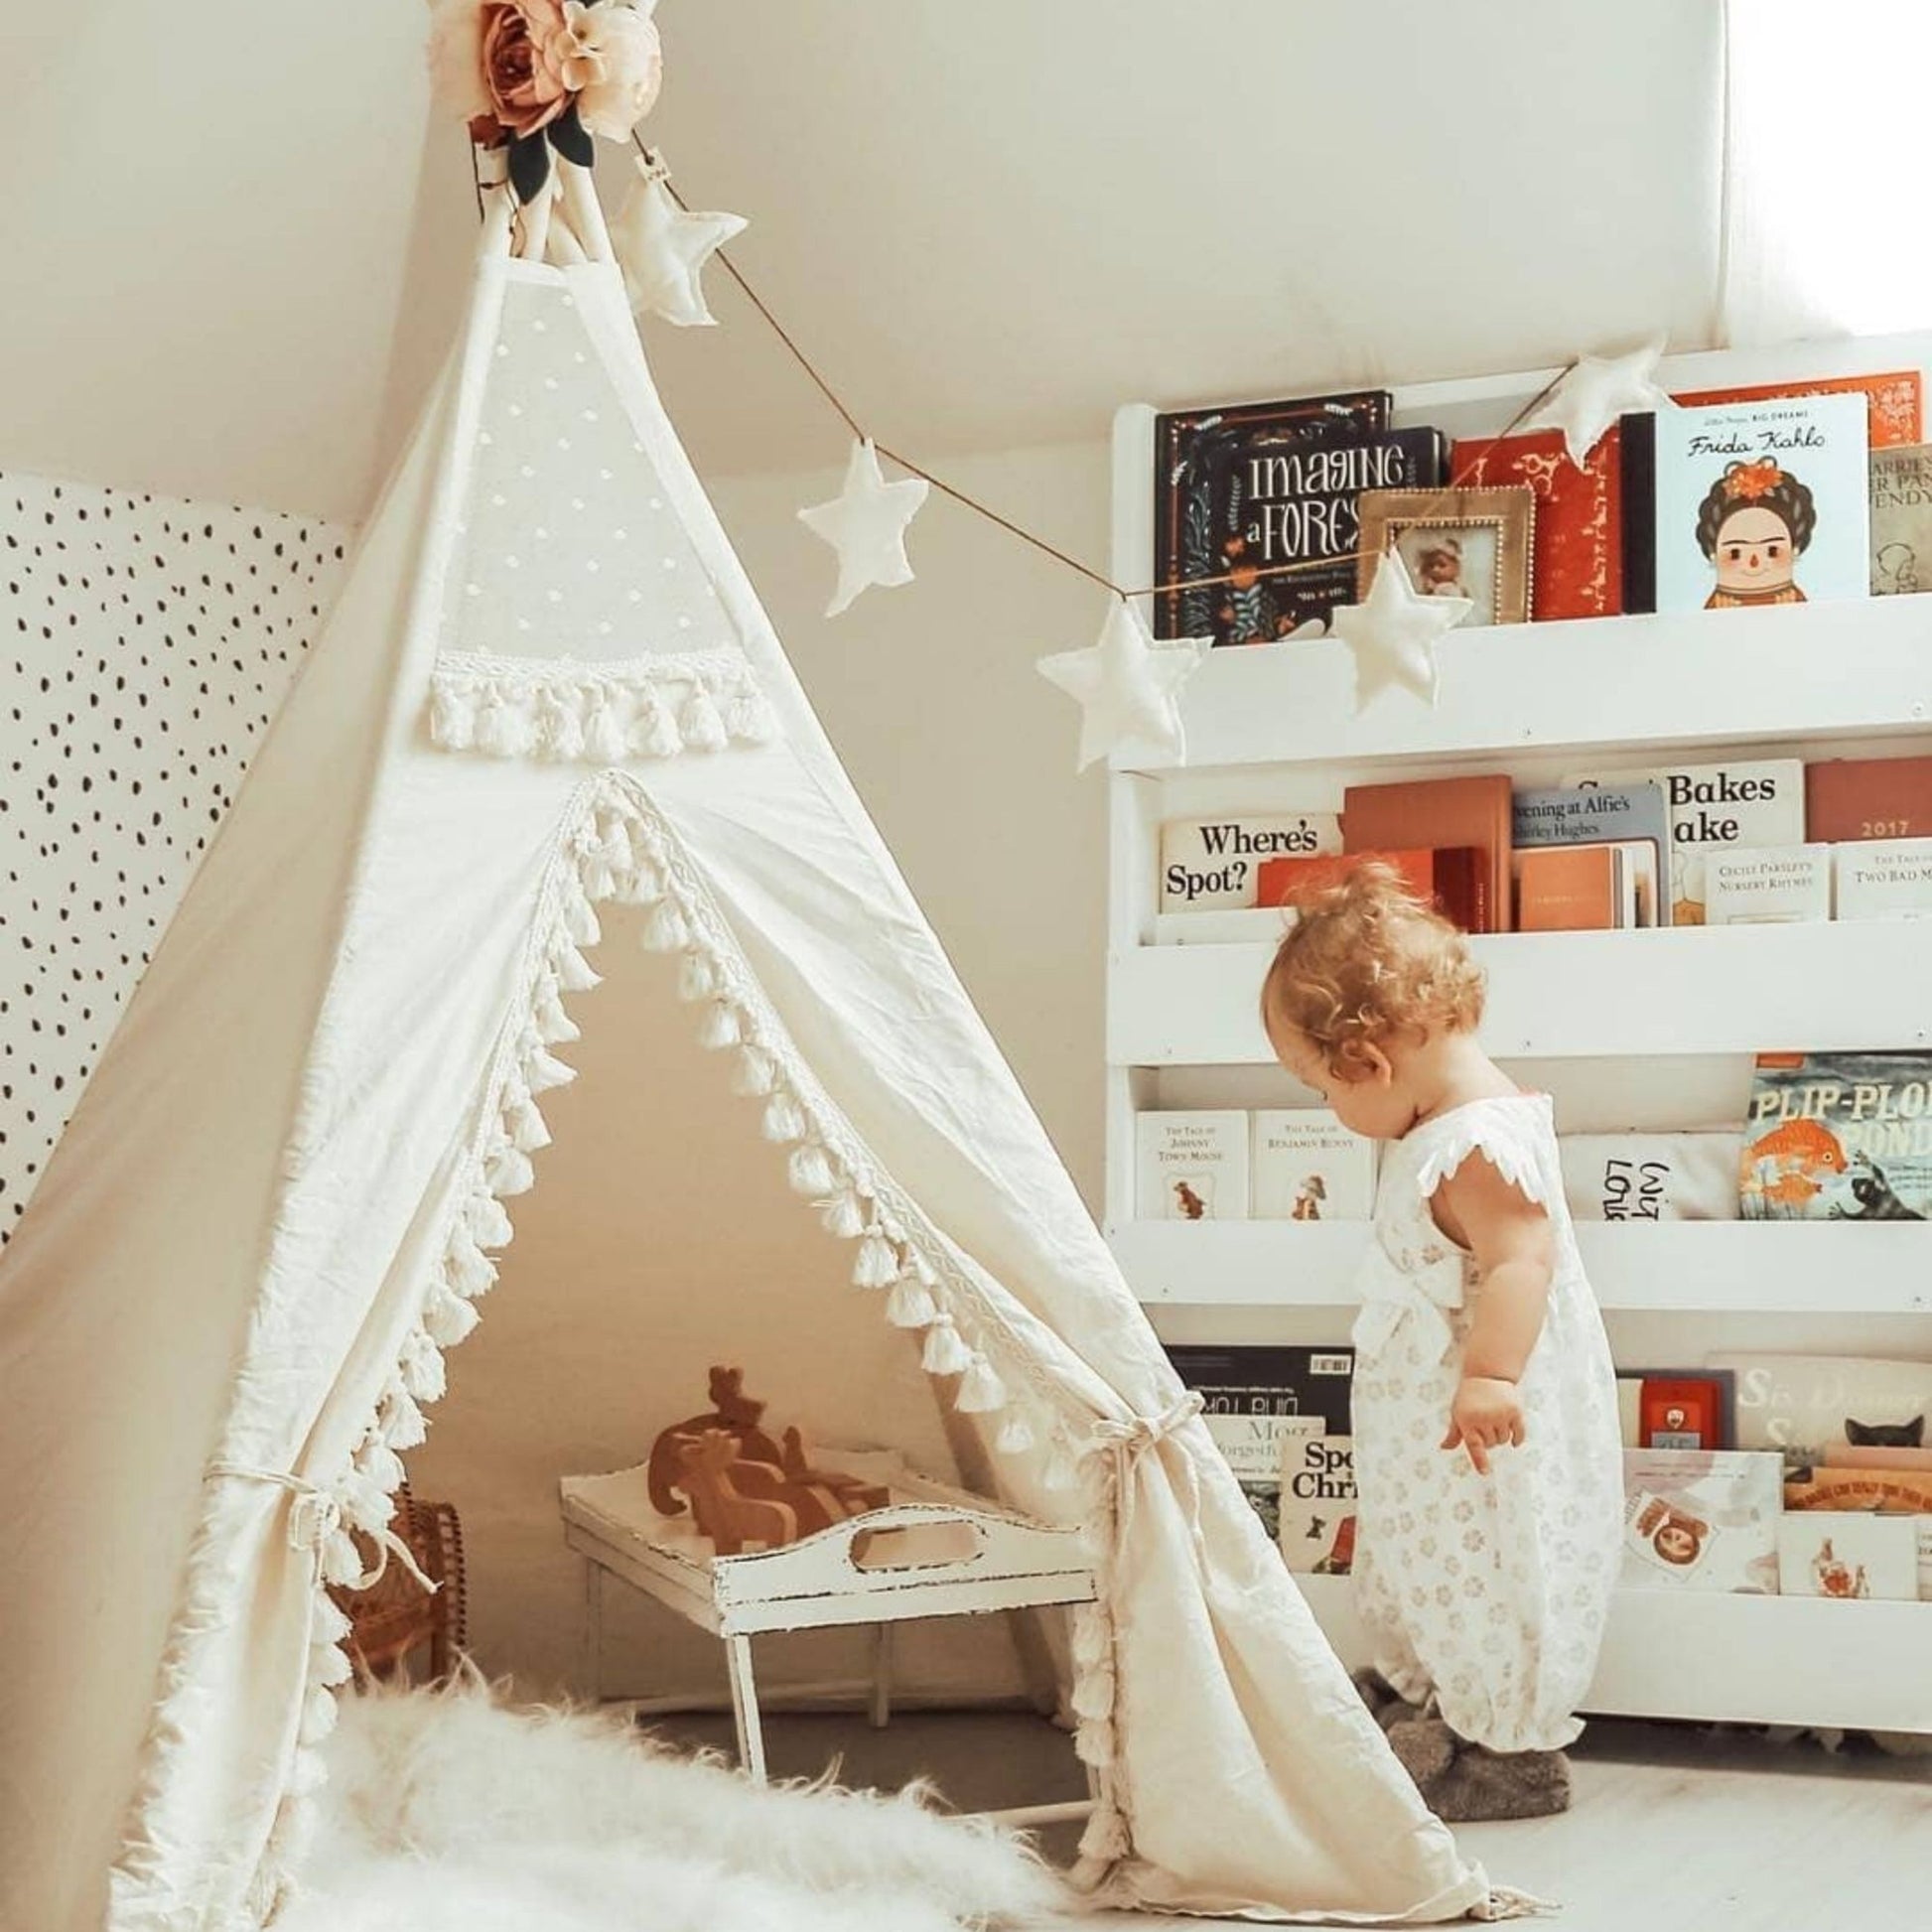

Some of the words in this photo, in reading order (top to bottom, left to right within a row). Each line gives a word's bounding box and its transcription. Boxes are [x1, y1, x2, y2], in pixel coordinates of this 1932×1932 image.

[1688, 432, 1752, 457] Frida
[1757, 426, 1826, 451] Kahlo
[1875, 488, 1932, 509] ENDY
[1246, 521, 1261, 544] a
[1666, 771, 1776, 806] Bakes
[1513, 799, 1566, 822] vening
[1567, 801, 1581, 815] at
[1584, 794, 1630, 814] Alfie's
[1199, 819, 1318, 855] Where's
[1554, 822, 1599, 839] Hughes
[1673, 811, 1739, 844] ake
[1861, 820, 1910, 838] 2017
[1166, 862, 1248, 900] Spot?
[1855, 870, 1887, 883] TWO
[1889, 869, 1917, 882] BAD
